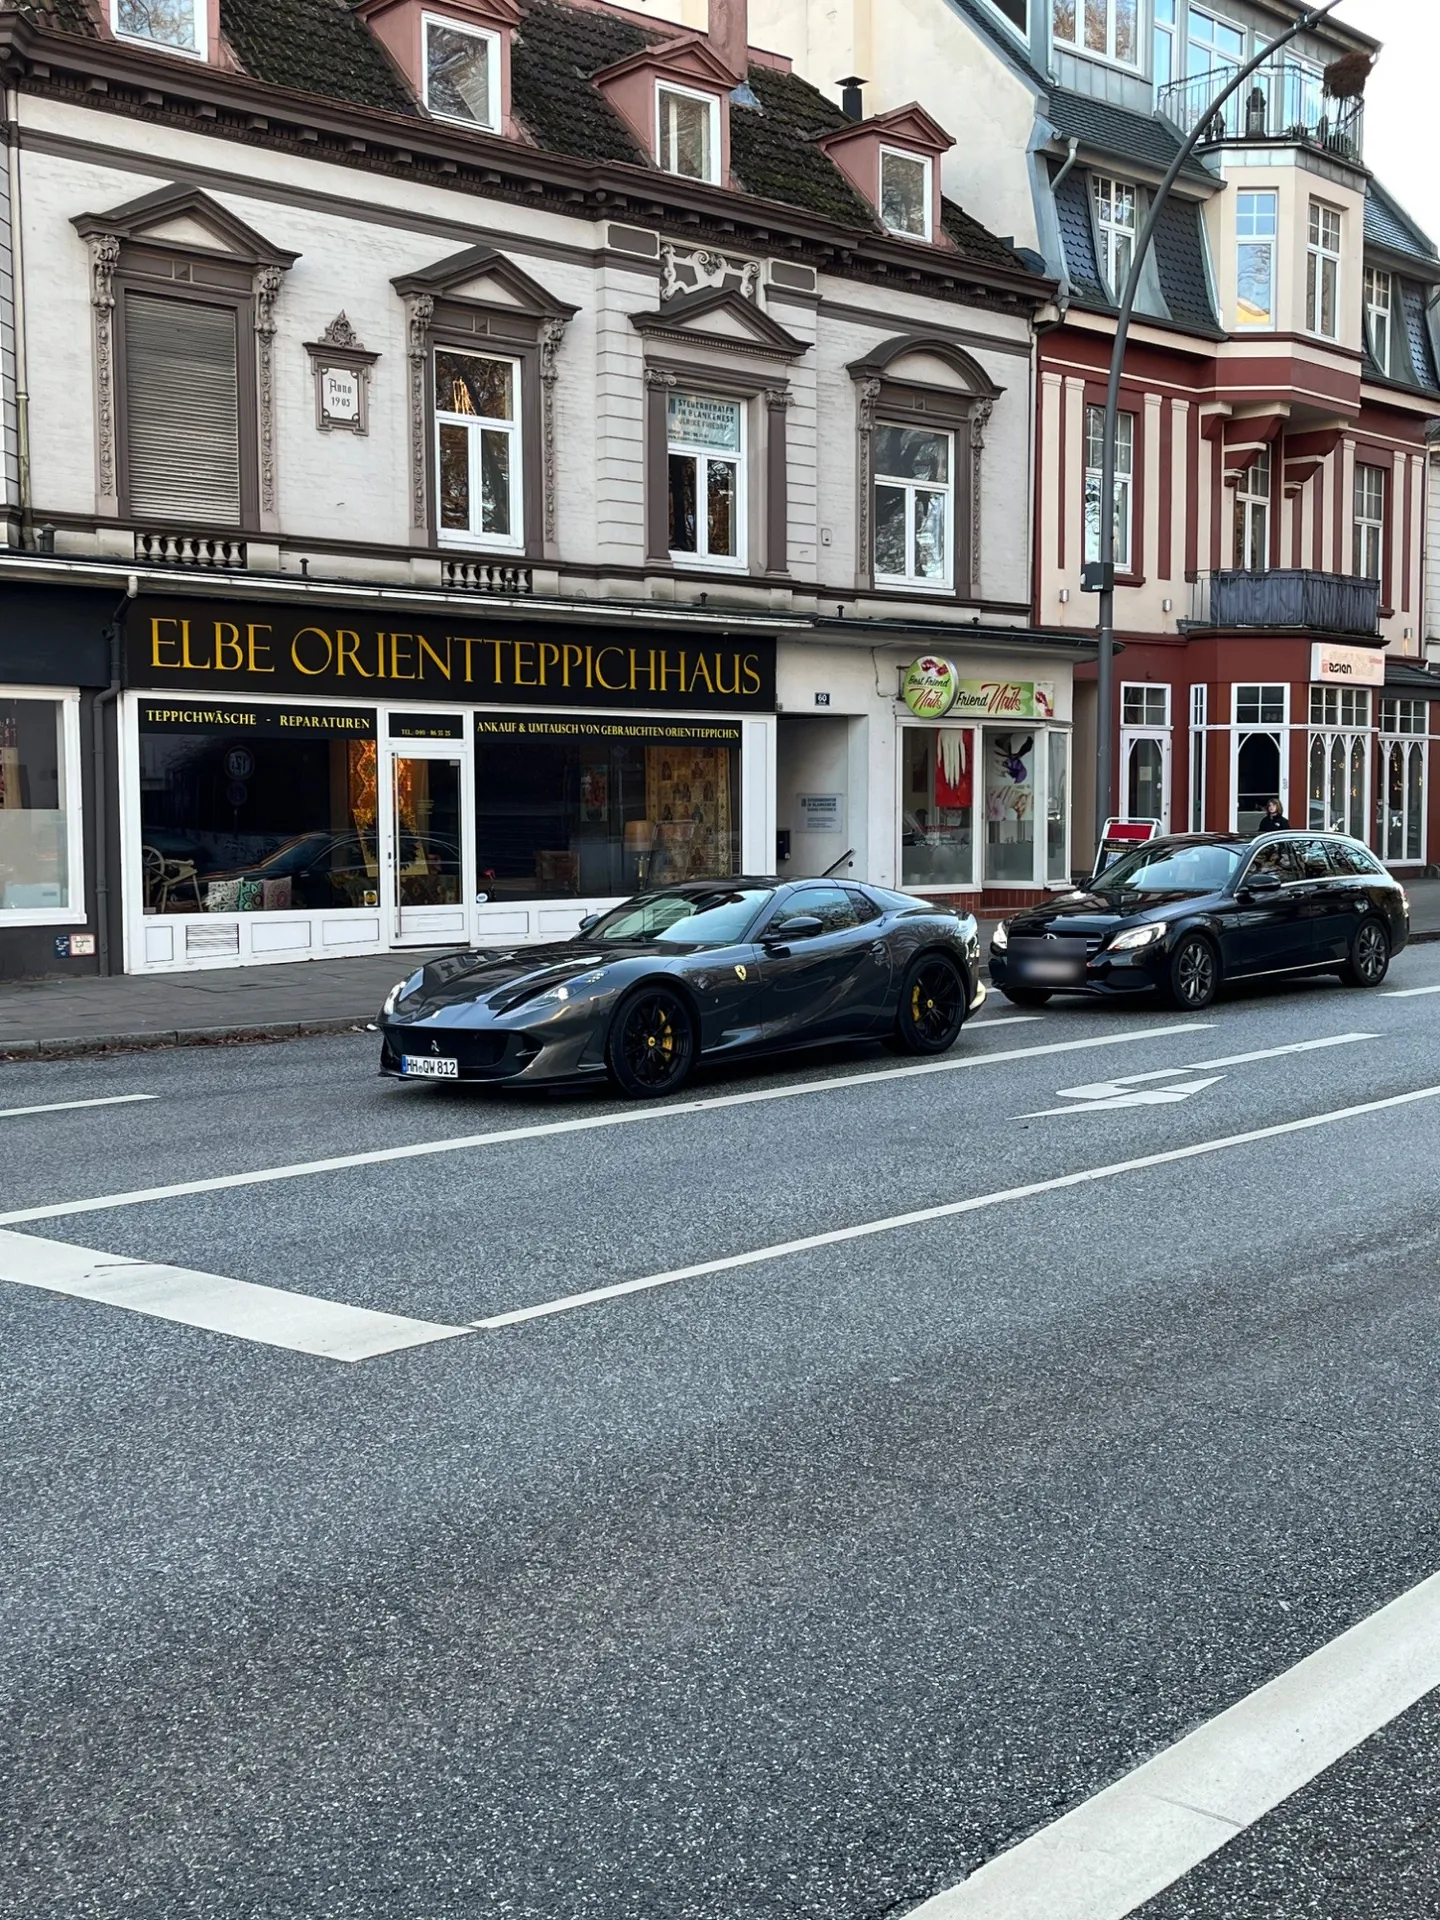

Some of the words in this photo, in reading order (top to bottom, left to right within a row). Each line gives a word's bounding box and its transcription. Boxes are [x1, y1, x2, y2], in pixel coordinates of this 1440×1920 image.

[328, 378, 352, 394] Anno
[331, 396, 350, 407] 1905
[149, 617, 275, 672] ELBE
[291, 627, 761, 694] ORIENTTEPPICHHAUS
[1329, 662, 1352, 674] asien
[908, 675, 924, 684] Best
[924, 676, 950, 688] Friend
[909, 687, 943, 709] Nails
[957, 691, 988, 707] Friend
[981, 683, 1021, 714] Nails
[146, 709, 257, 725] TEPPICHWÄSCHE
[280, 715, 371, 729] REPARATUREN
[477, 721, 517, 733] ANKAUF
[518, 723, 526, 733] &
[528, 722, 579, 734] UMTAUSCH
[580, 723, 600, 735] VON
[601, 725, 664, 737] GEBRAUCHTEN
[665, 727, 739, 739] ORIENTTEPPICHEN
[437, 1061, 456, 1075] 812
